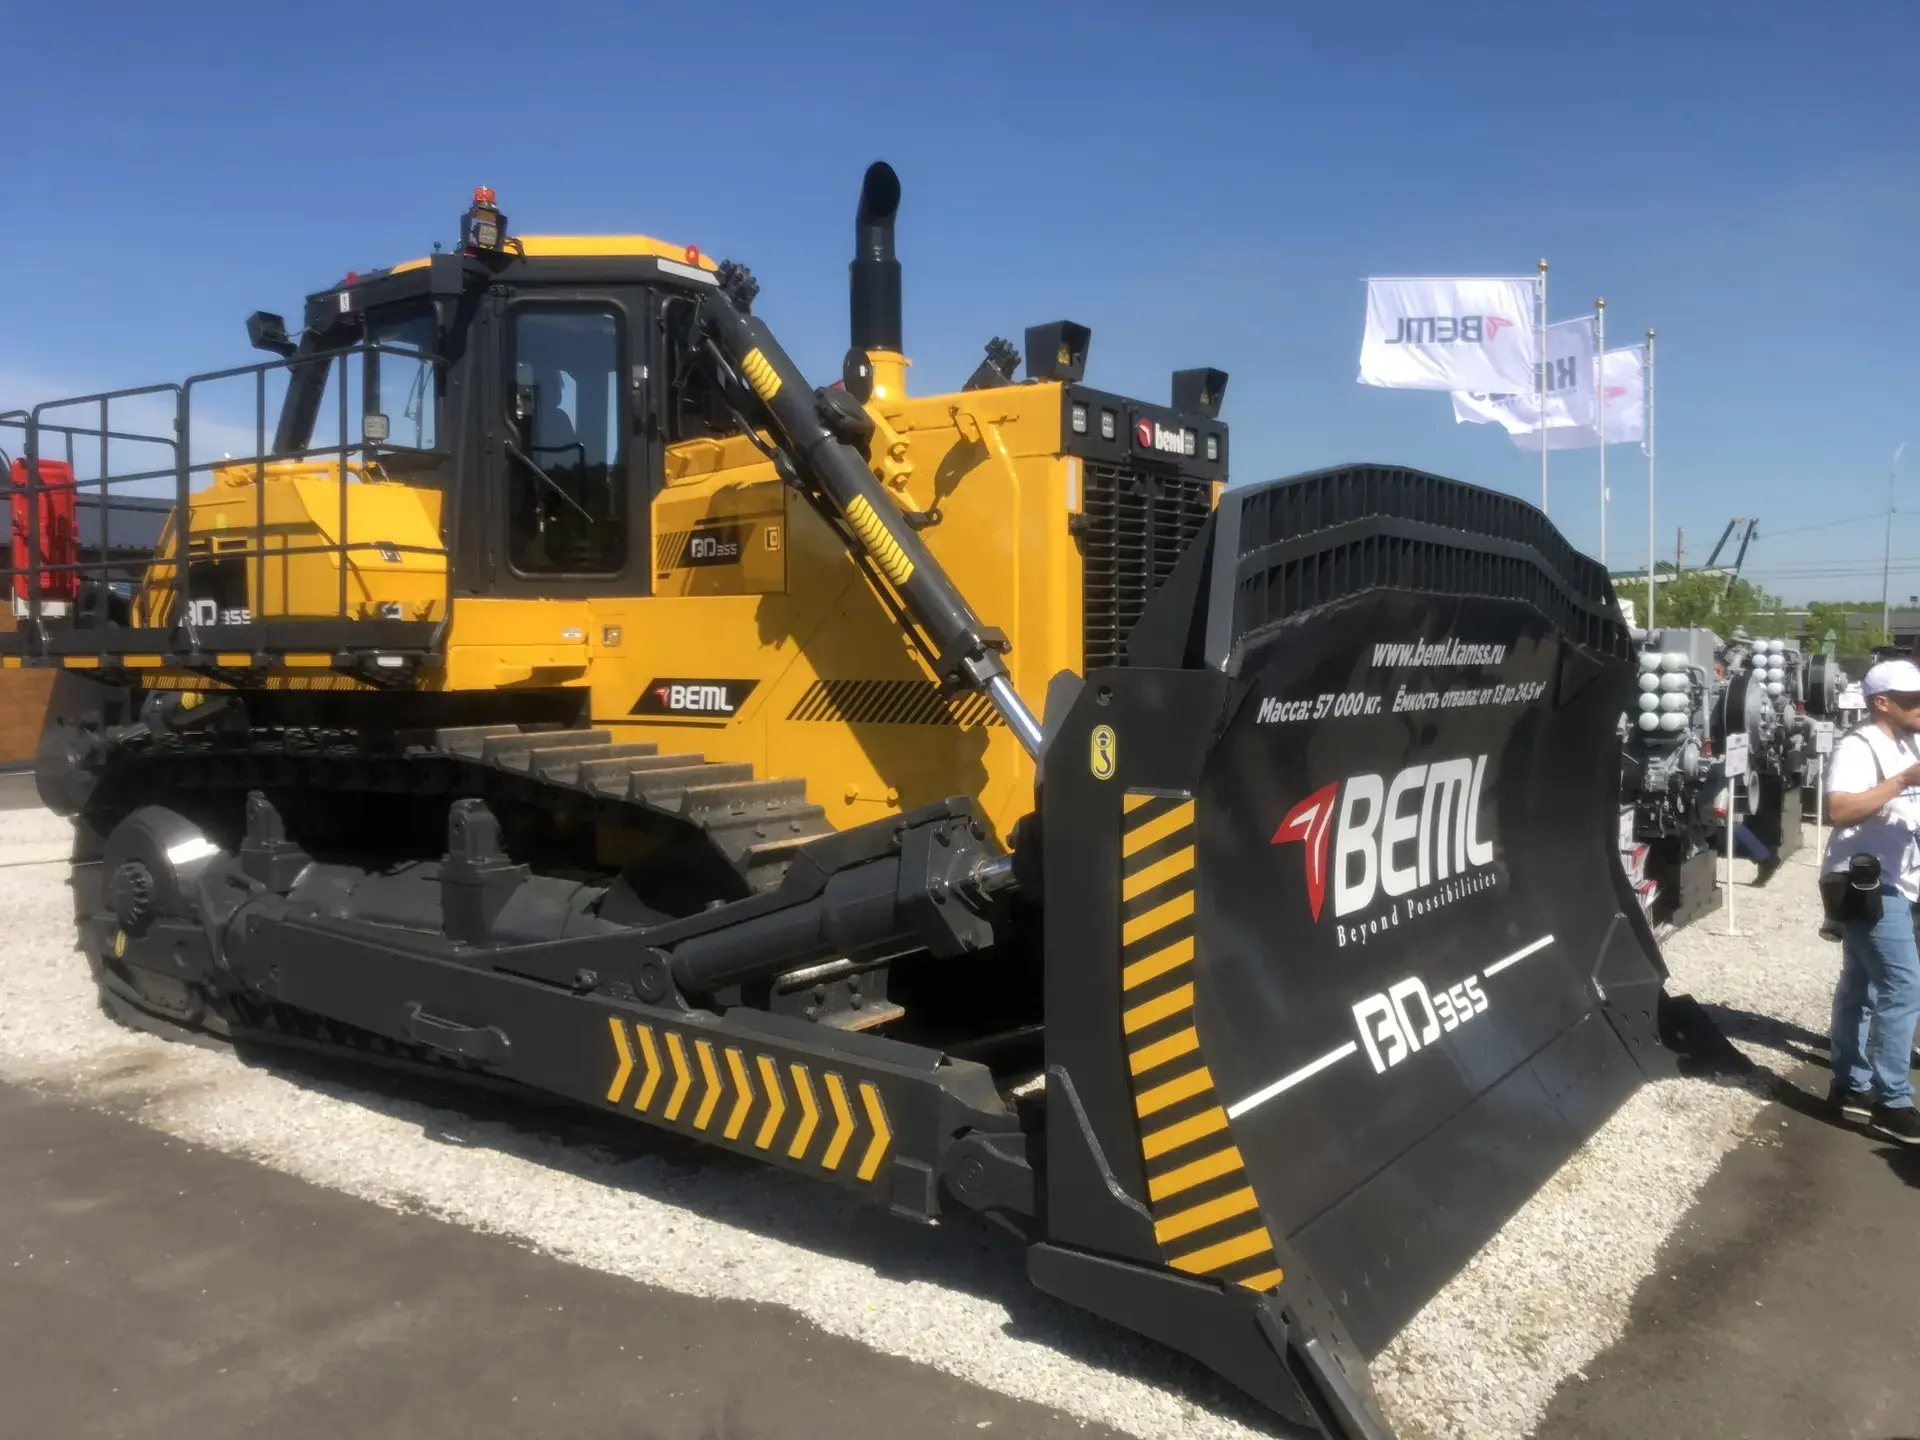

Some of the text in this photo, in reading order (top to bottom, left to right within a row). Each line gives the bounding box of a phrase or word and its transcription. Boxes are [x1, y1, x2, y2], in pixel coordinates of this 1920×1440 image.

[1155, 423, 1185, 454] beml
[691, 537, 738, 558] BD355
[1371, 637, 1506, 667] www.beml.kamss.ru
[670, 685, 733, 711] BEML
[1256, 697, 1313, 723] Масса:
[1312, 694, 1335, 719] 57
[1334, 692, 1364, 717] 000
[1364, 696, 1382, 714] кг.
[1392, 684, 1440, 712] Ёмкость
[1441, 689, 1481, 708] отвала:
[1480, 689, 1494, 704] от
[1501, 688, 1516, 705] до
[1334, 755, 1494, 918] BEML
[1336, 872, 1497, 947] Beyond Possibilities
[1352, 975, 1489, 1074] BD355
